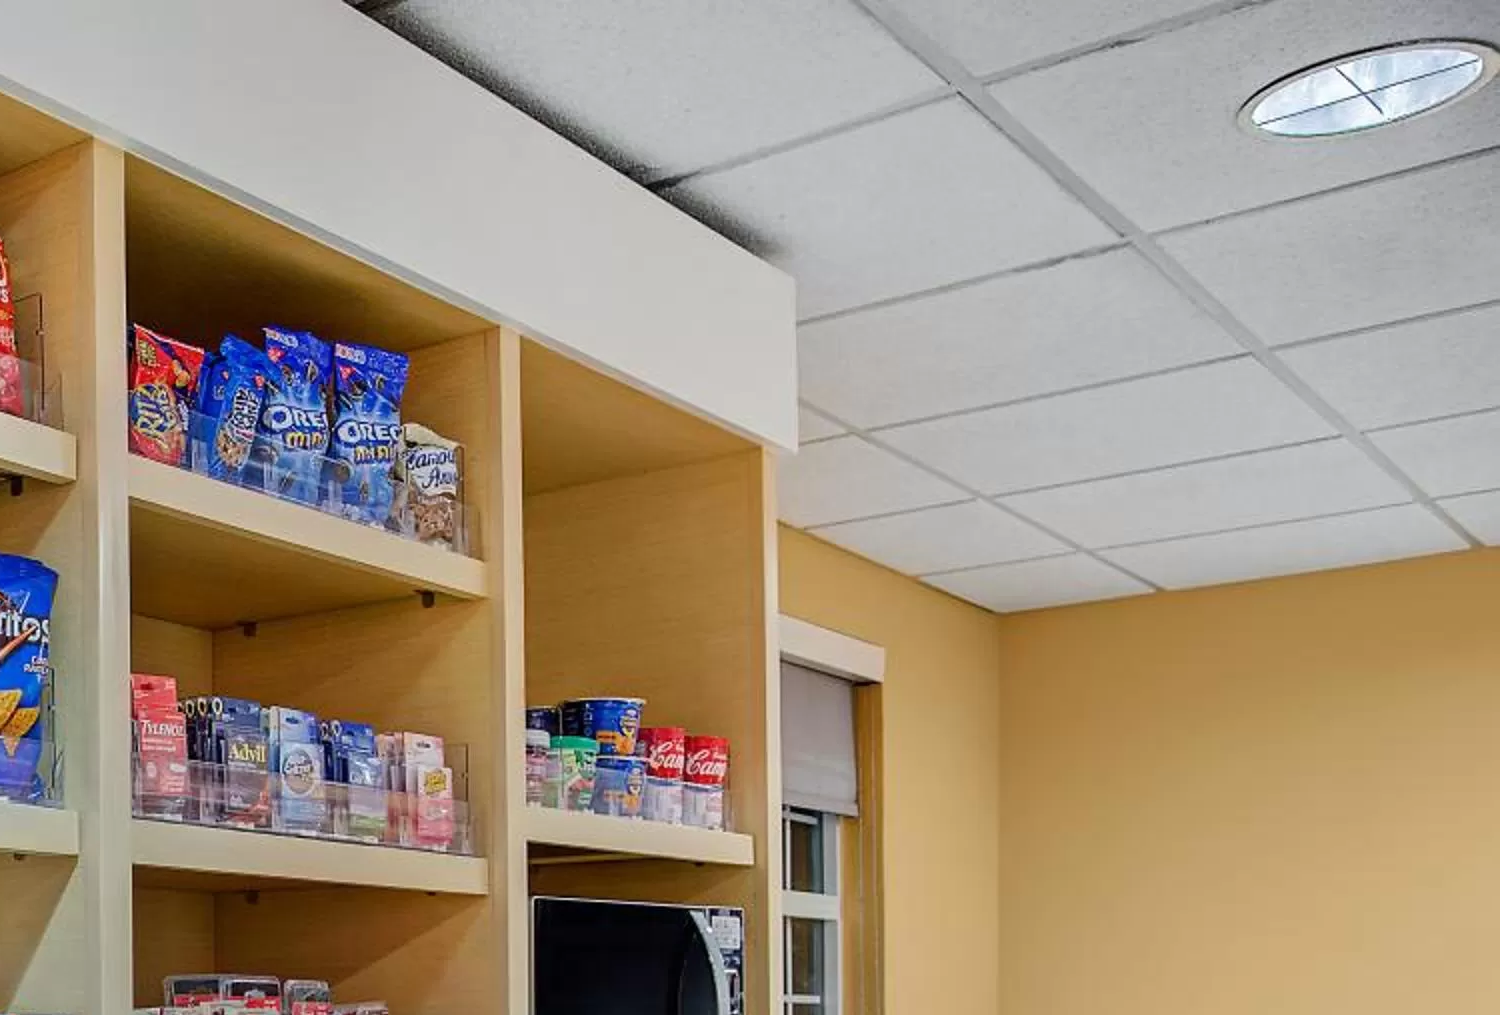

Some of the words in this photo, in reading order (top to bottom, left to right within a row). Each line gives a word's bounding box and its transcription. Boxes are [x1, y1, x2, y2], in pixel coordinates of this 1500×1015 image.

[263, 405, 329, 431] ORE
[404, 450, 455, 470] Famou
[141, 718, 187, 737] TYLENOL
[227, 742, 266, 764] Advil
